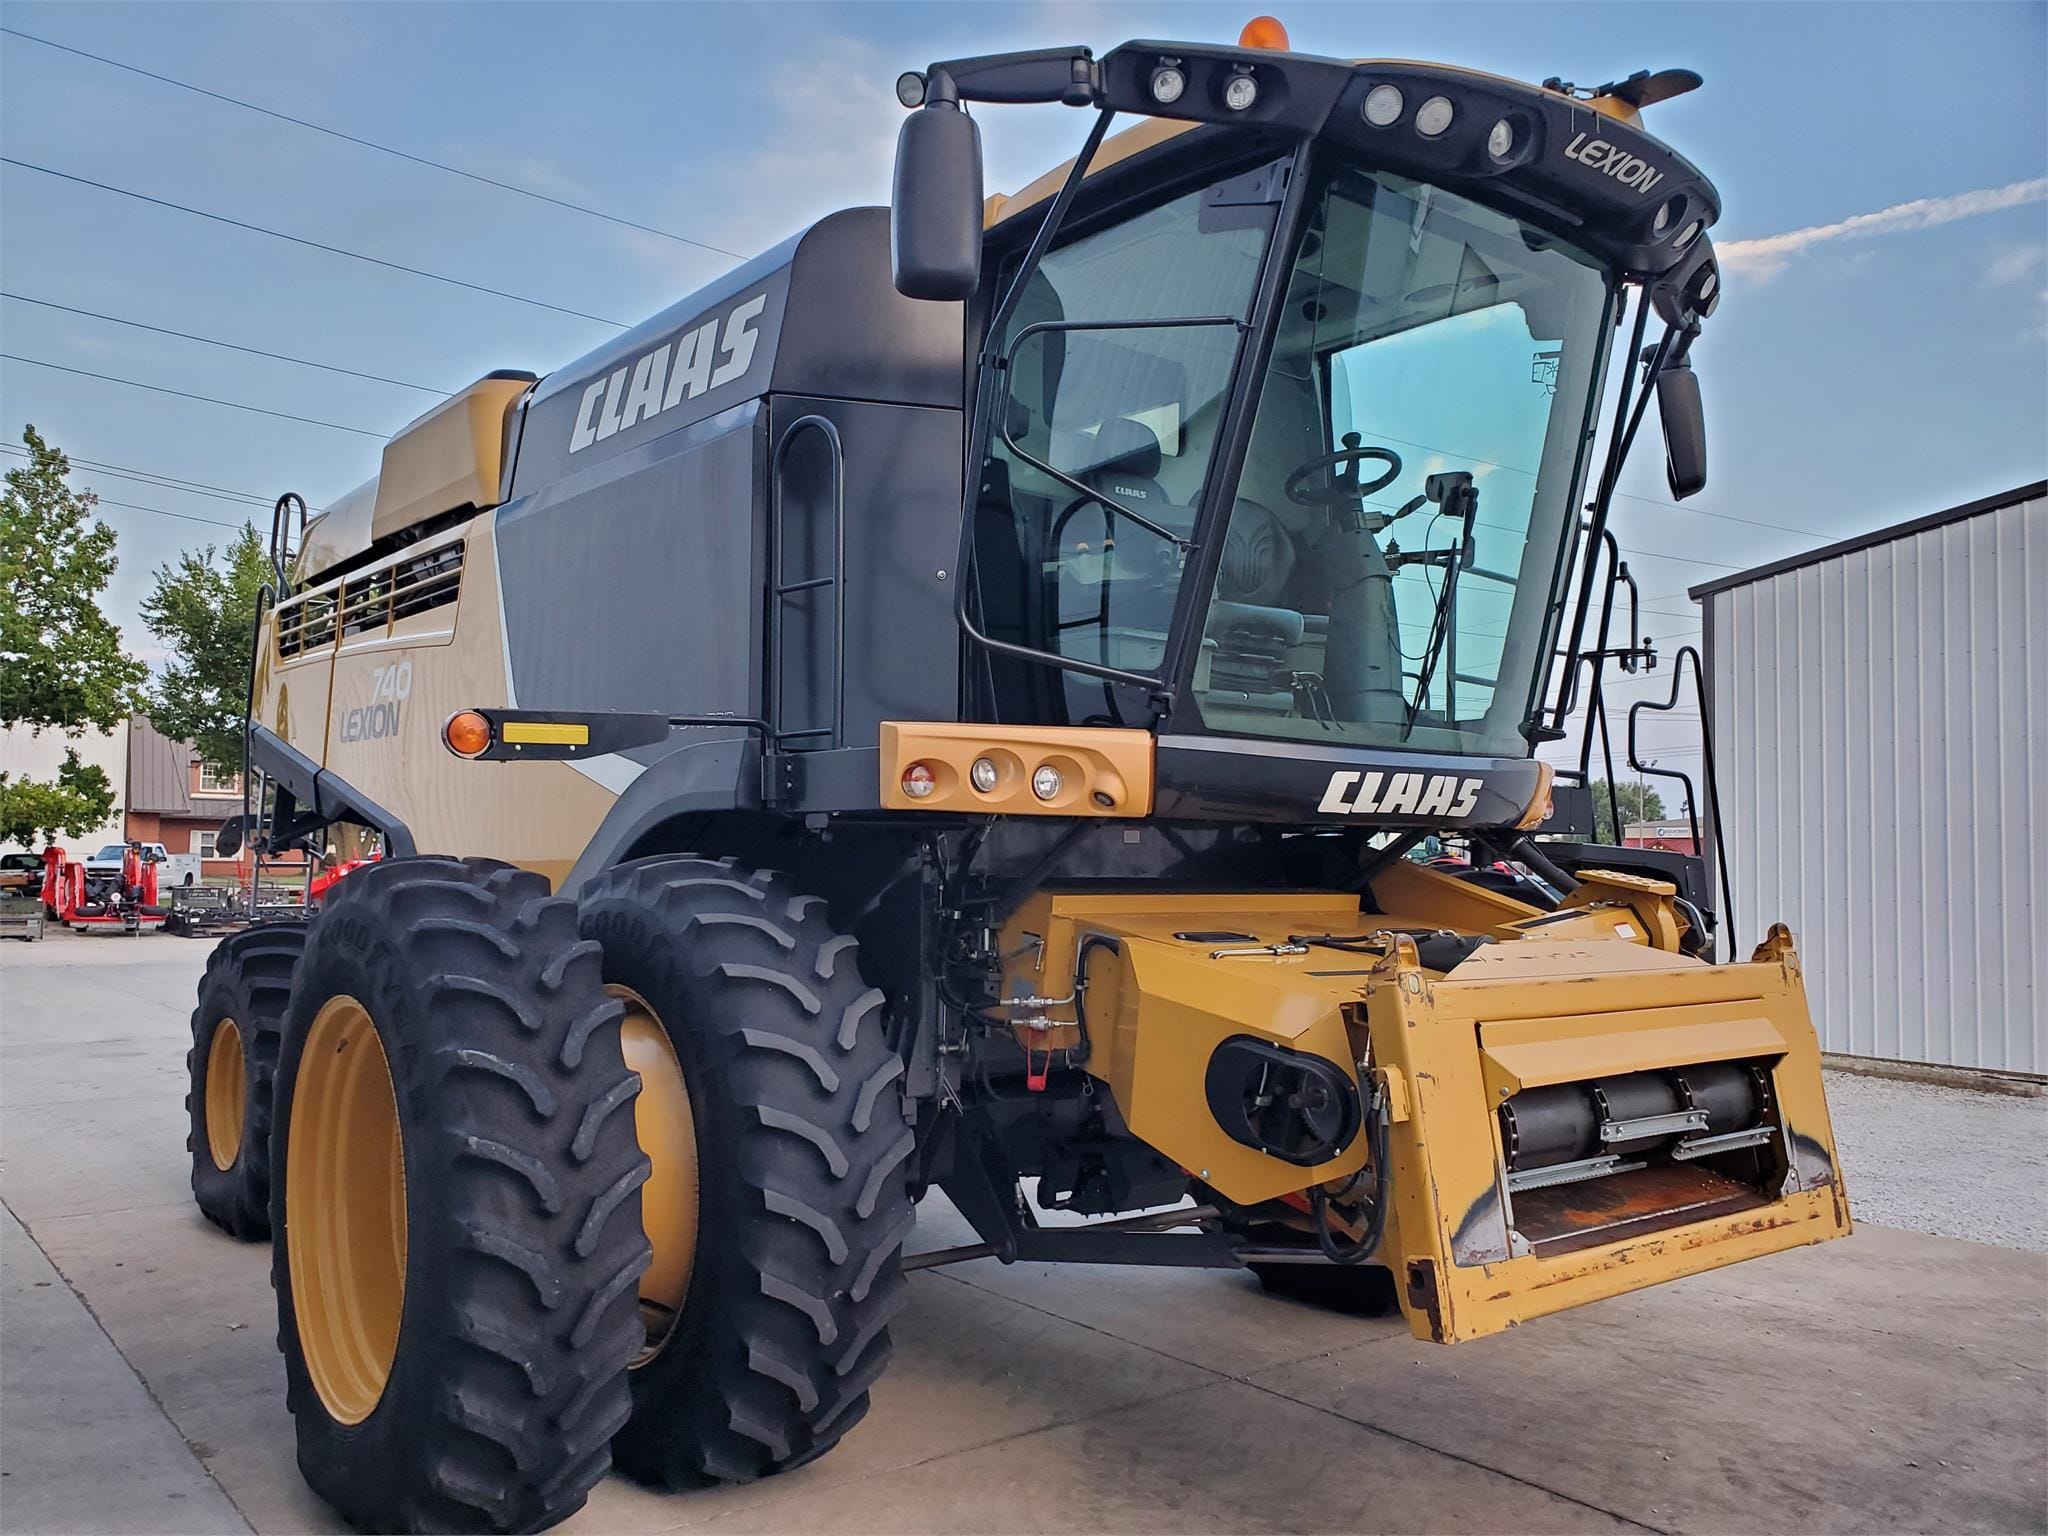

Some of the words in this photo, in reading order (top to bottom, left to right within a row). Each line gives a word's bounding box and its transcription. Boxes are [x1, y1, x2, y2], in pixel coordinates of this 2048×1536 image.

[1564, 132, 1664, 194] LEXION
[569, 293, 767, 454] CLAAS
[1115, 486, 1147, 499] CLAAS
[371, 660, 413, 705] 740
[340, 700, 402, 743] LEXION
[1317, 770, 1484, 818] CLAAS
